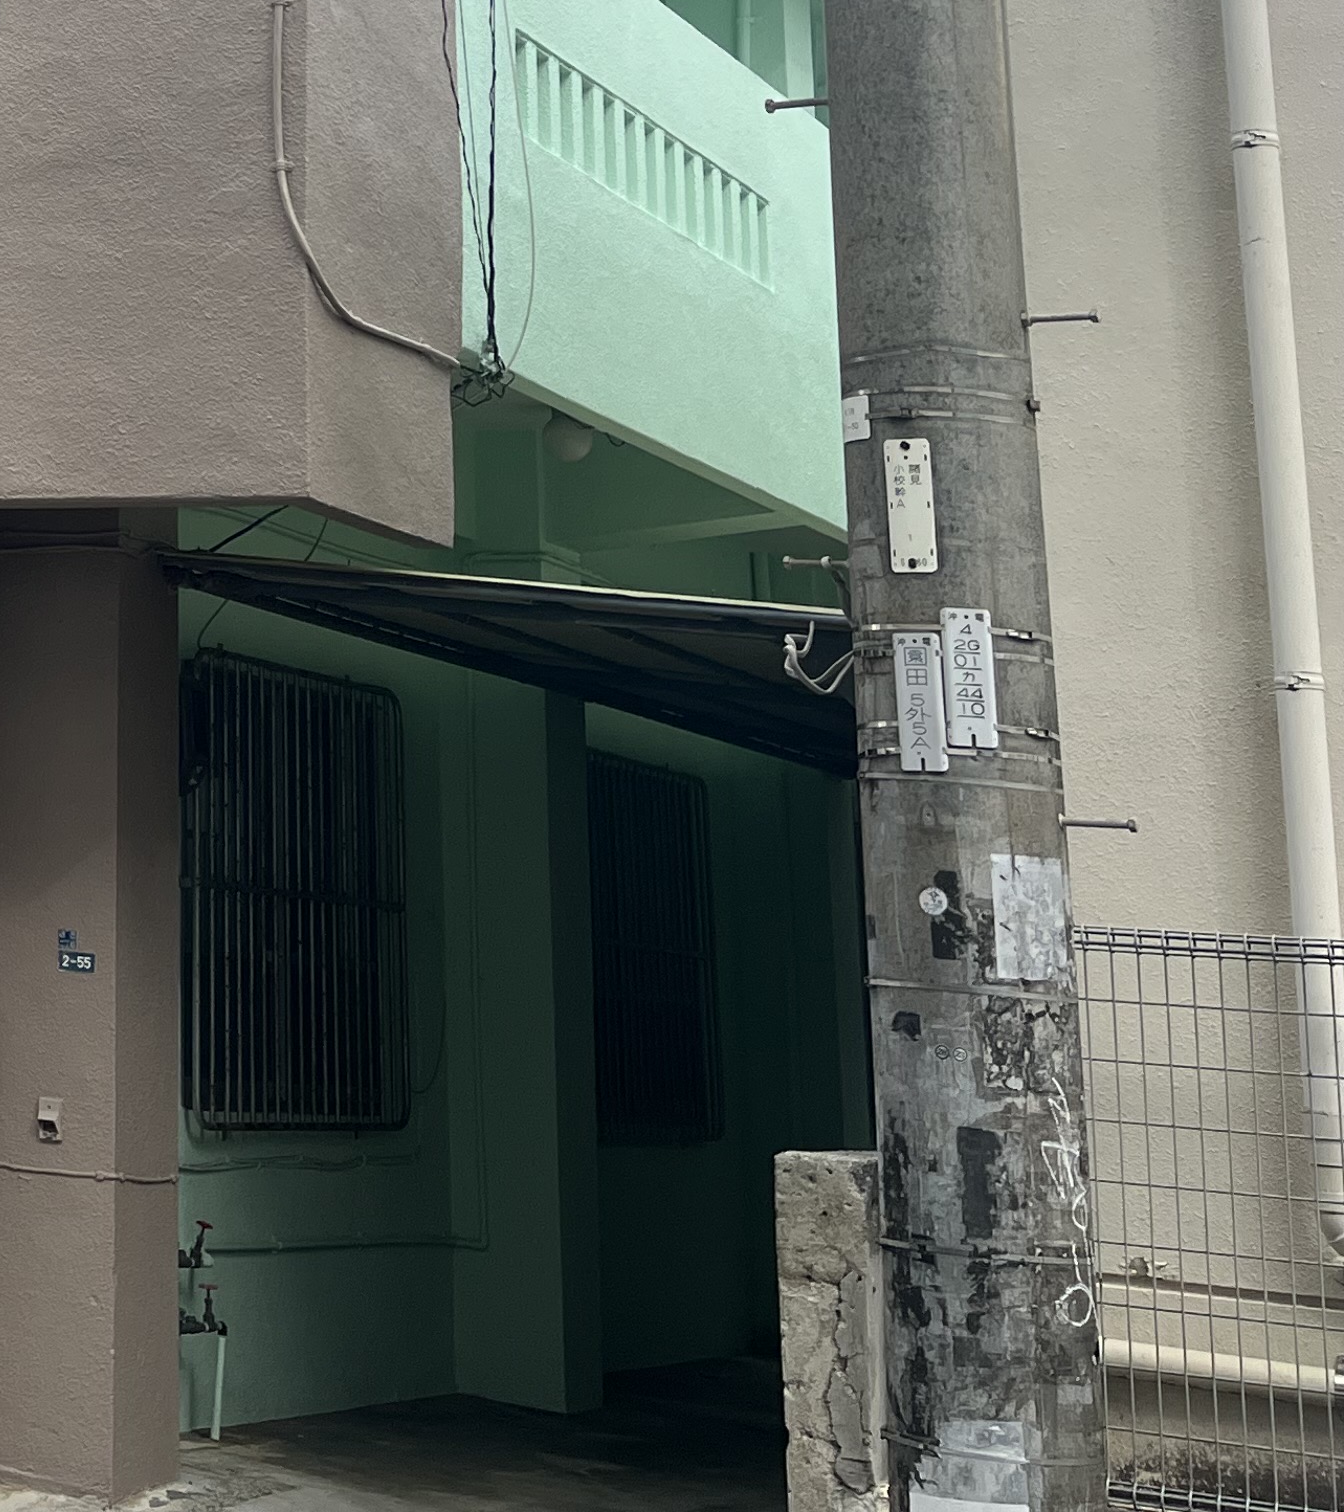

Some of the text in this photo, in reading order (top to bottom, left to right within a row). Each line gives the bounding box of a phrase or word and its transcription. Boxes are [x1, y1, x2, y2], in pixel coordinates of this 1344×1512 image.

[953, 639, 980, 651] 2G
[956, 687, 983, 699] 44
[62, 954, 91, 970] 2-55
